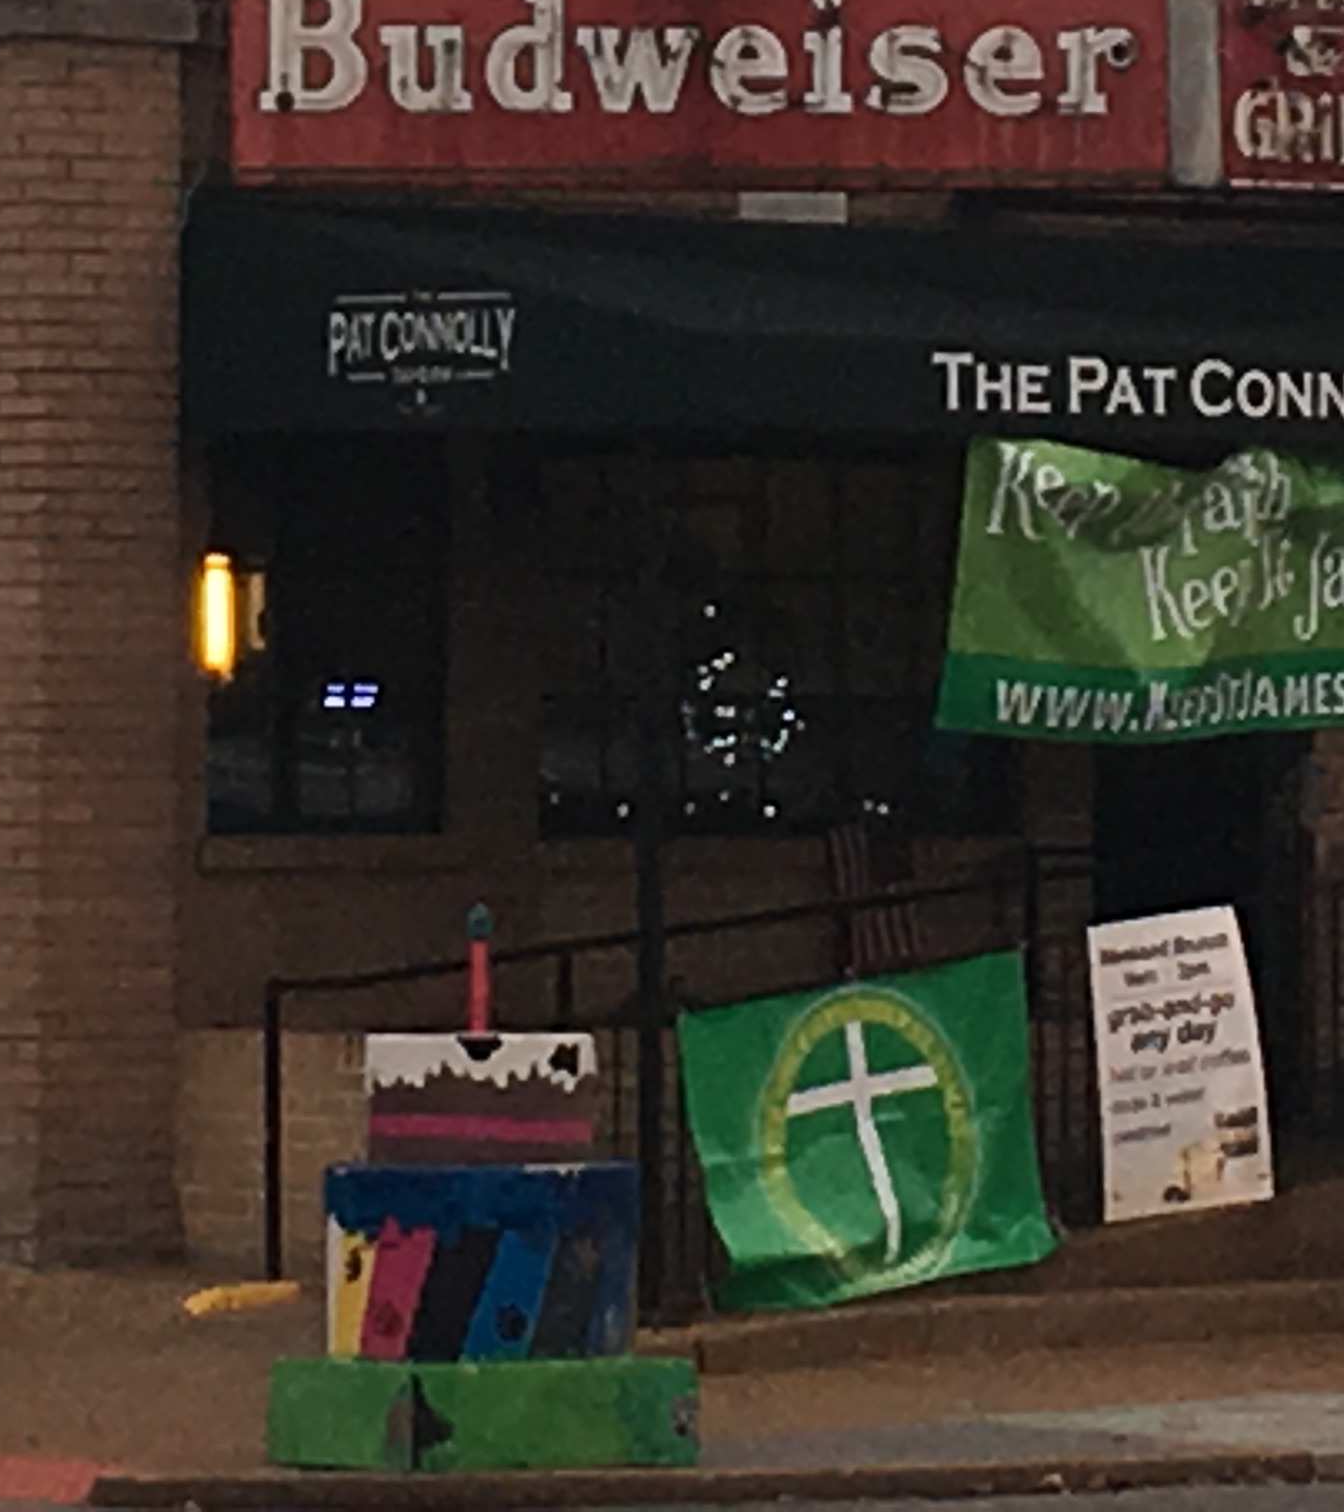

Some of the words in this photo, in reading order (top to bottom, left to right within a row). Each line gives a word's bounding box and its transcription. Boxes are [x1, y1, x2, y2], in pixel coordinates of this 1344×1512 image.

[327, 310, 377, 377] PAT
[379, 307, 517, 372] CONNOLLY
[931, 350, 1053, 416] THE
[1067, 355, 1177, 418] PAT
[1176, 1020, 1216, 1043] day
